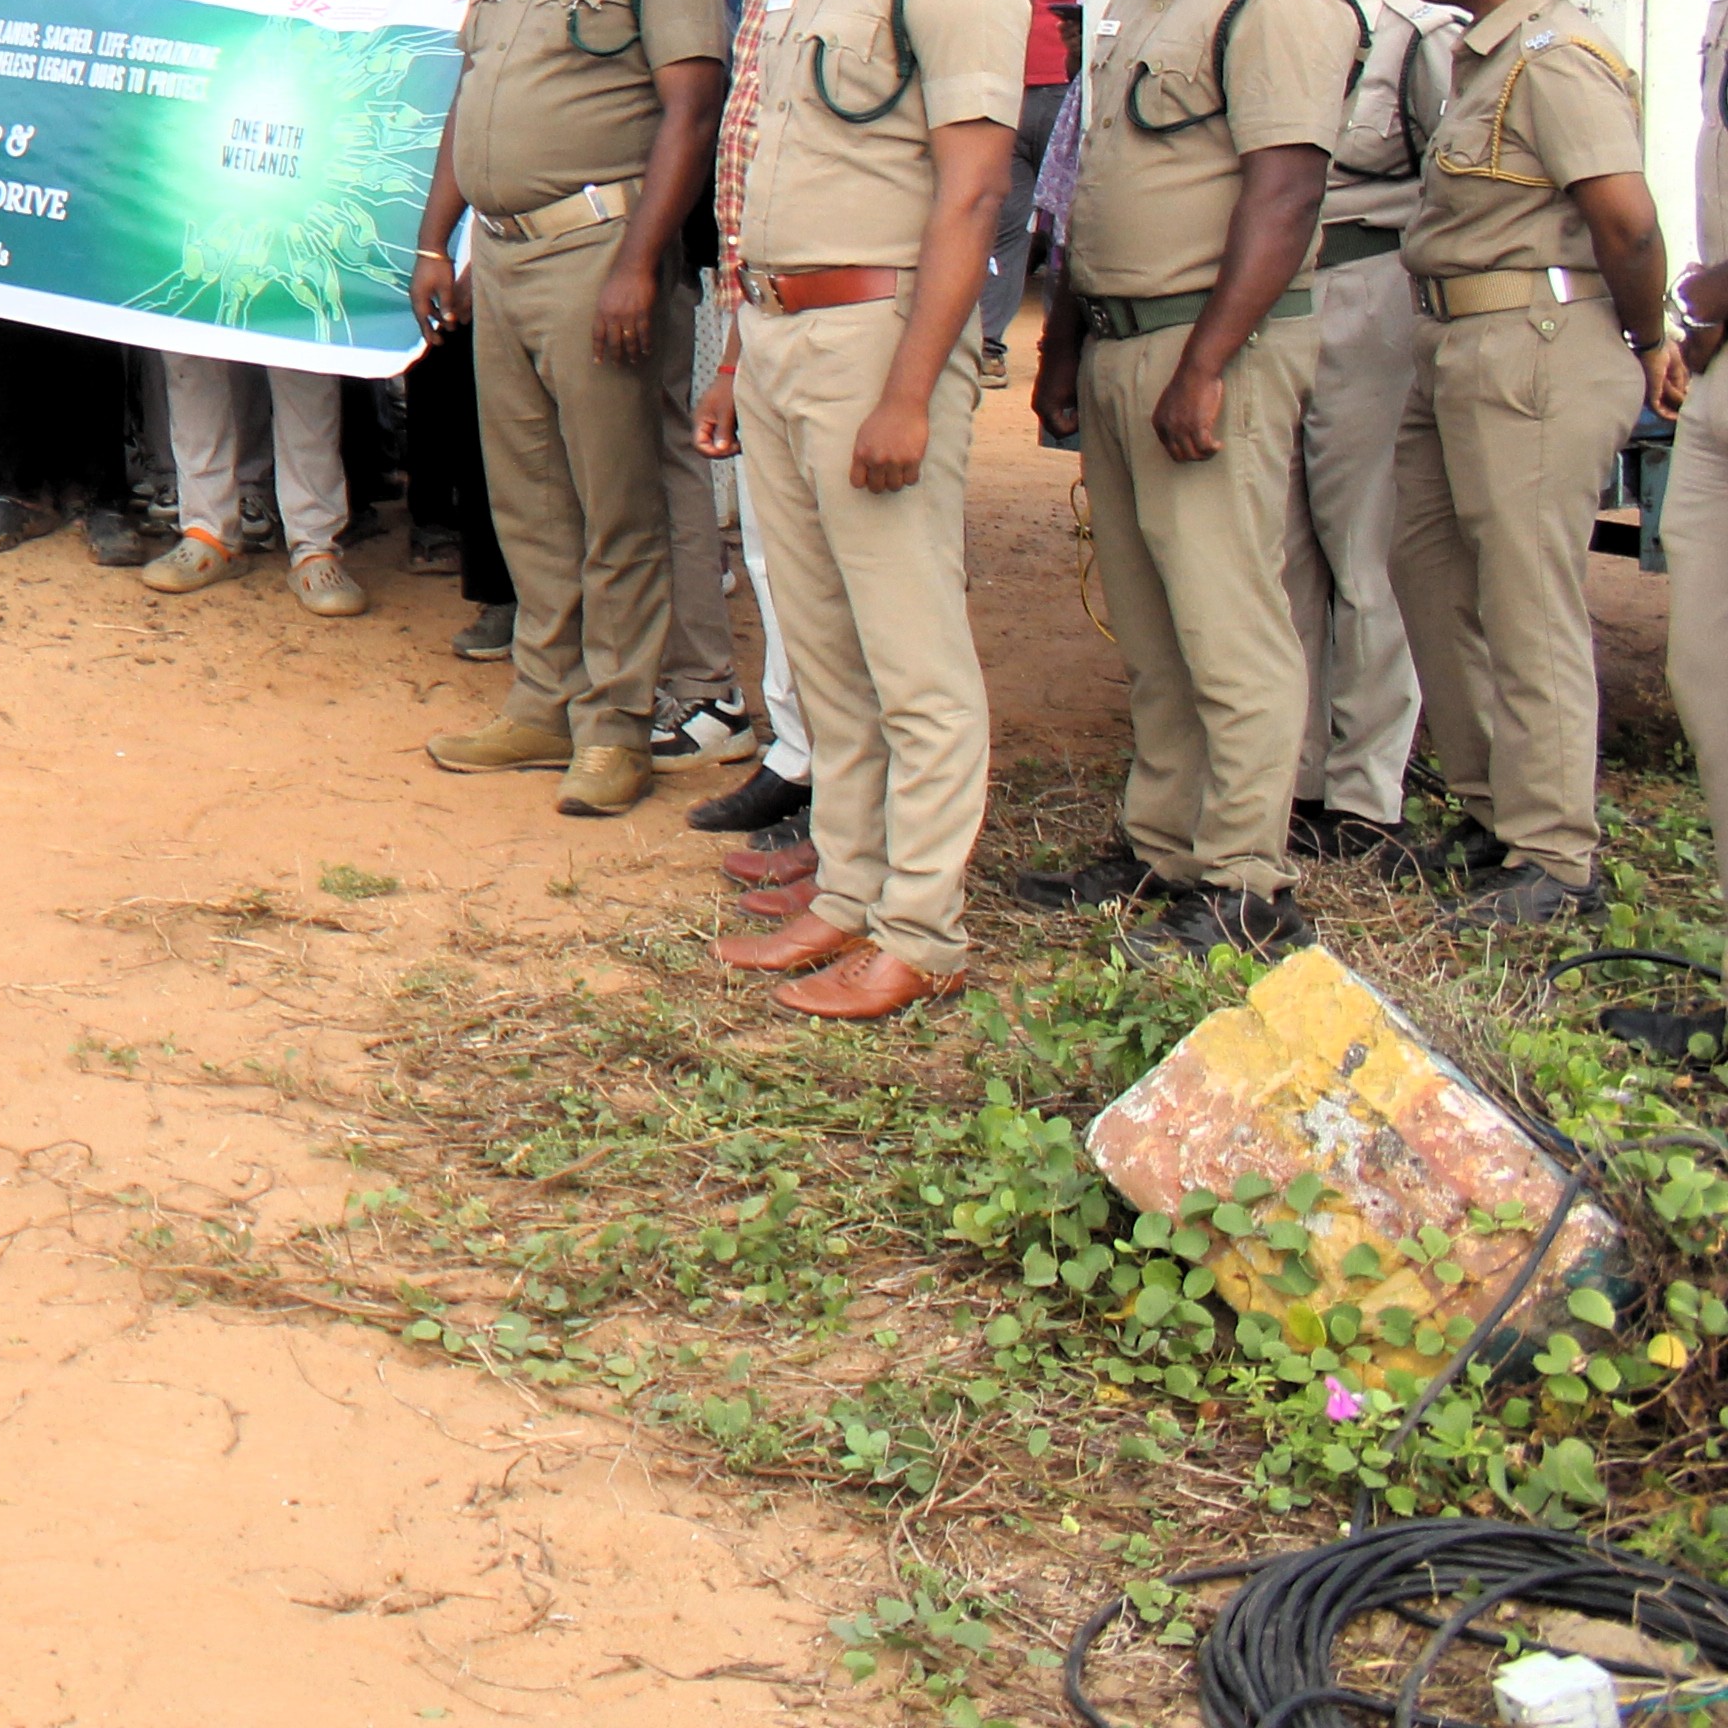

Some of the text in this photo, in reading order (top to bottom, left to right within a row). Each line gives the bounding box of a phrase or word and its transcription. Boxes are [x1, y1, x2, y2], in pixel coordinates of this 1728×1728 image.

[37, 56, 86, 86] LEGACY.
[88, 62, 126, 91] OURS
[127, 66, 146, 94] TO
[5, 124, 35, 158] &
[231, 118, 304, 150] ONE WITH
[222, 145, 301, 179] WETLANDS.
